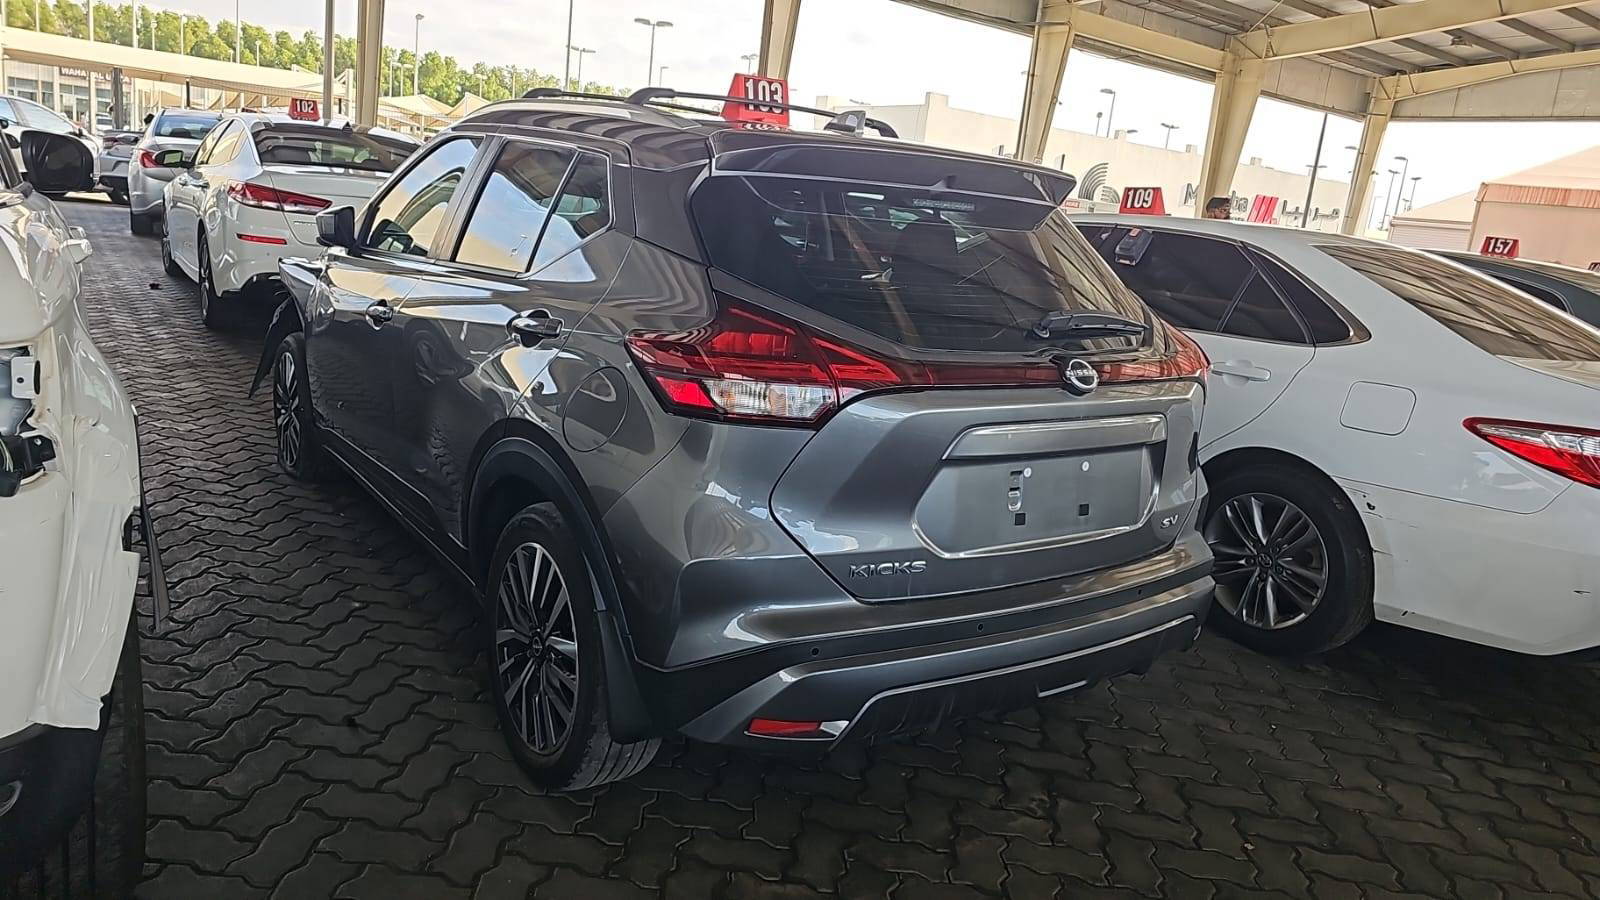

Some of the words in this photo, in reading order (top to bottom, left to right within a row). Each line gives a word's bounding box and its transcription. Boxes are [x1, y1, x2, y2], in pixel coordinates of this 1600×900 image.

[296, 96, 314, 113] 102
[745, 79, 783, 114] 103
[1127, 188, 1154, 208] 109
[1488, 239, 1513, 254] 157
[1162, 514, 1178, 528] SV
[849, 560, 927, 578] KICKS
